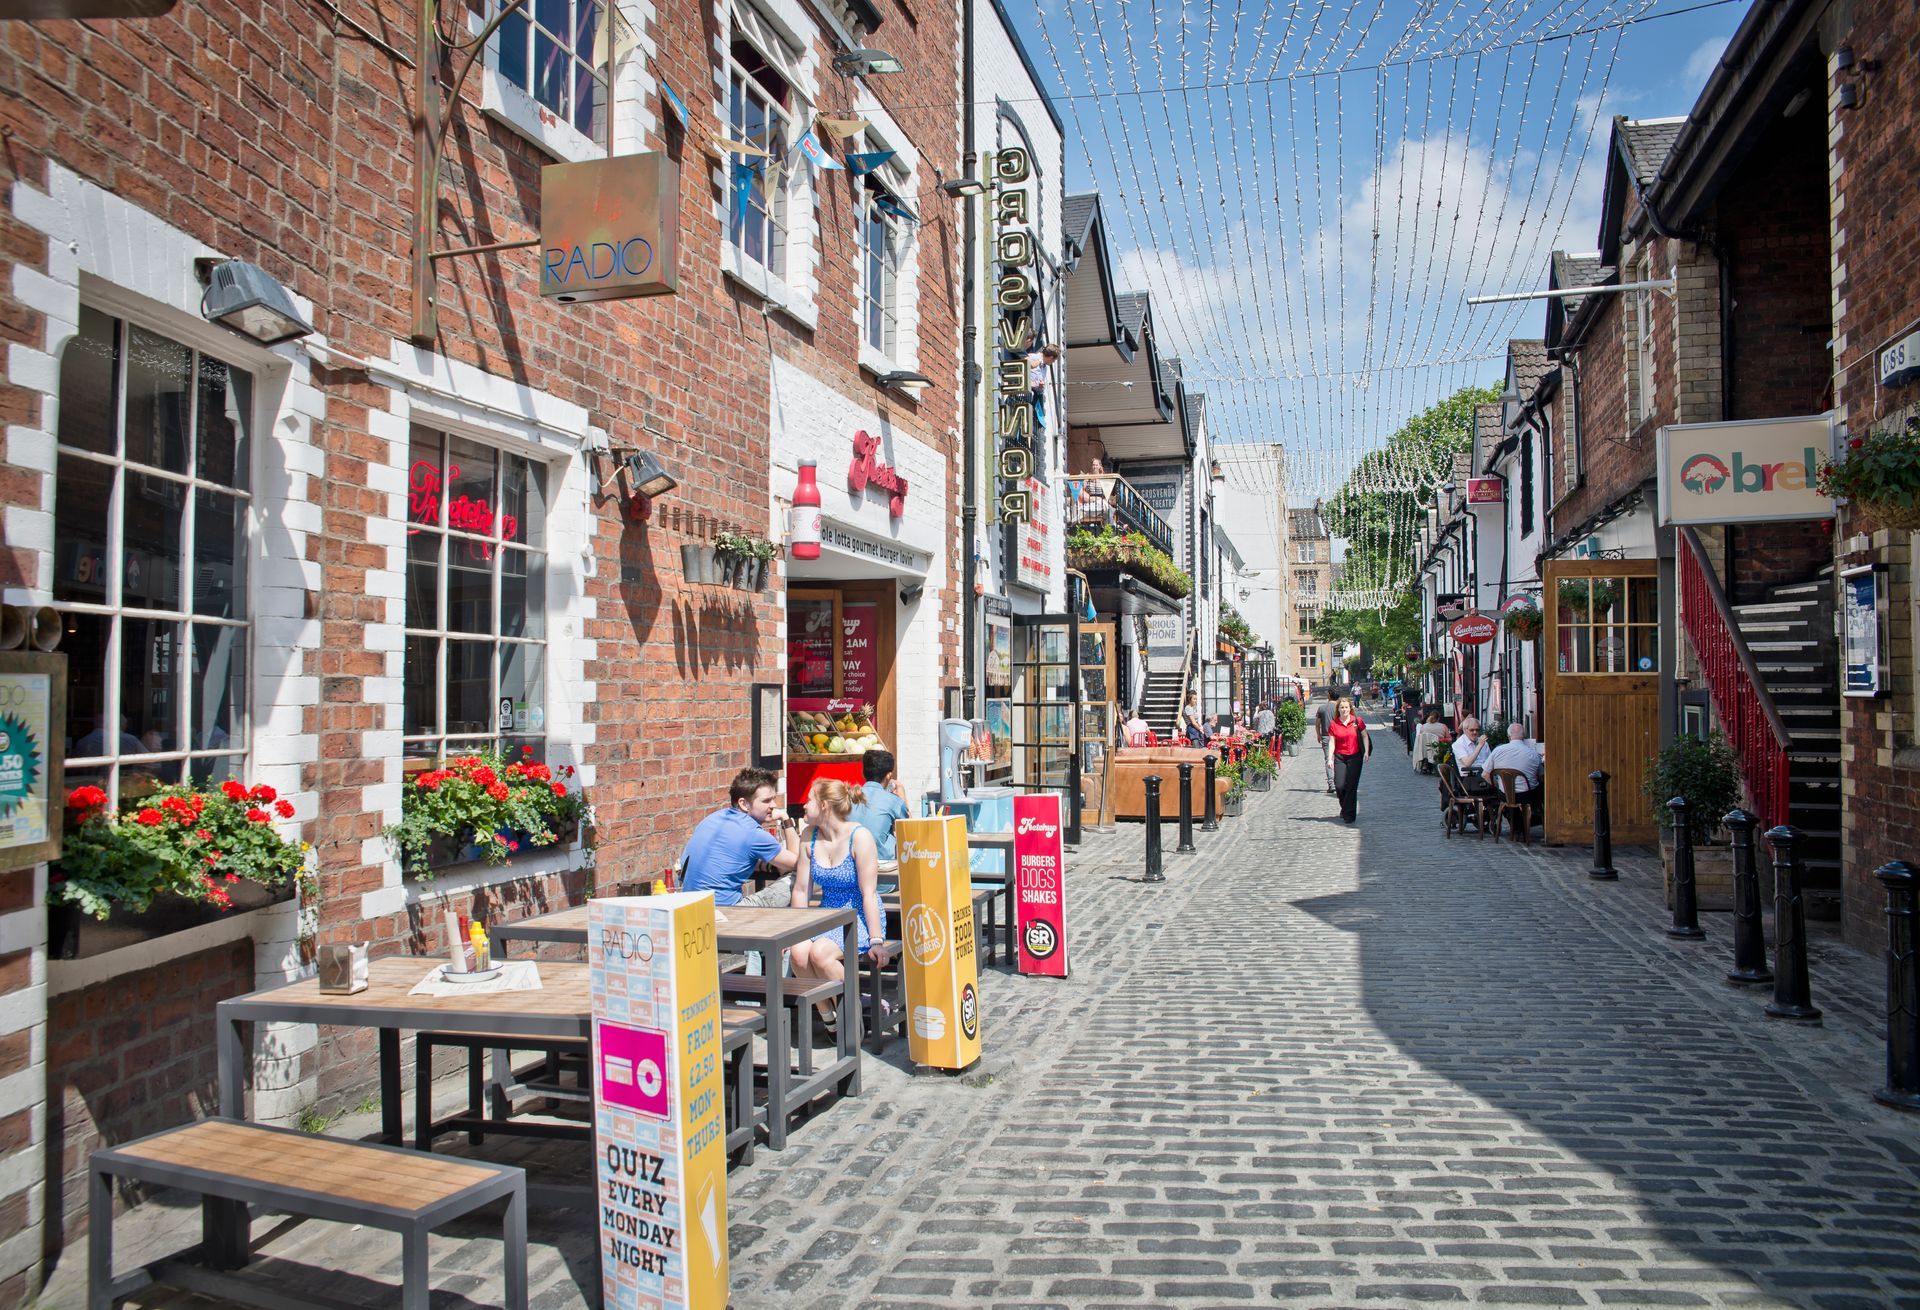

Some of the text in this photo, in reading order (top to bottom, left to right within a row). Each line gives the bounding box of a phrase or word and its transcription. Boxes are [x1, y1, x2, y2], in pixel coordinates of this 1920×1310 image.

[545, 237, 652, 285] RADIO
[1731, 447, 1818, 494] brel
[1152, 498, 1176, 509] THEATRE
[834, 528, 851, 549] lotta
[851, 537, 879, 556] gourmet
[879, 543, 899, 563] burger
[899, 549, 915, 567] lovin'
[846, 638, 868, 648] 1AM
[1454, 623, 1494, 637] Budweiser
[1017, 817, 1058, 839] Ketchup
[900, 840, 942, 869] Ketchup
[1021, 855, 1056, 868] BURGERS
[1021, 867, 1056, 889] DOGS
[1022, 890, 1057, 904] SHAKES
[953, 905, 971, 922] DRINKS
[602, 928, 655, 962] RADIO
[683, 922, 713, 961] RADIO
[954, 921, 973, 943] FOOD
[1030, 929, 1050, 945] SR
[955, 941, 973, 960] TUNES
[687, 1018, 714, 1055] FROM
[689, 1052, 715, 1088] £2.50
[687, 1114, 721, 1160] THURS
[607, 1143, 666, 1186] QUIZ
[608, 1179, 668, 1217] EVERY
[603, 1206, 675, 1248] MONDAY
[611, 1237, 668, 1277] NIGHT
